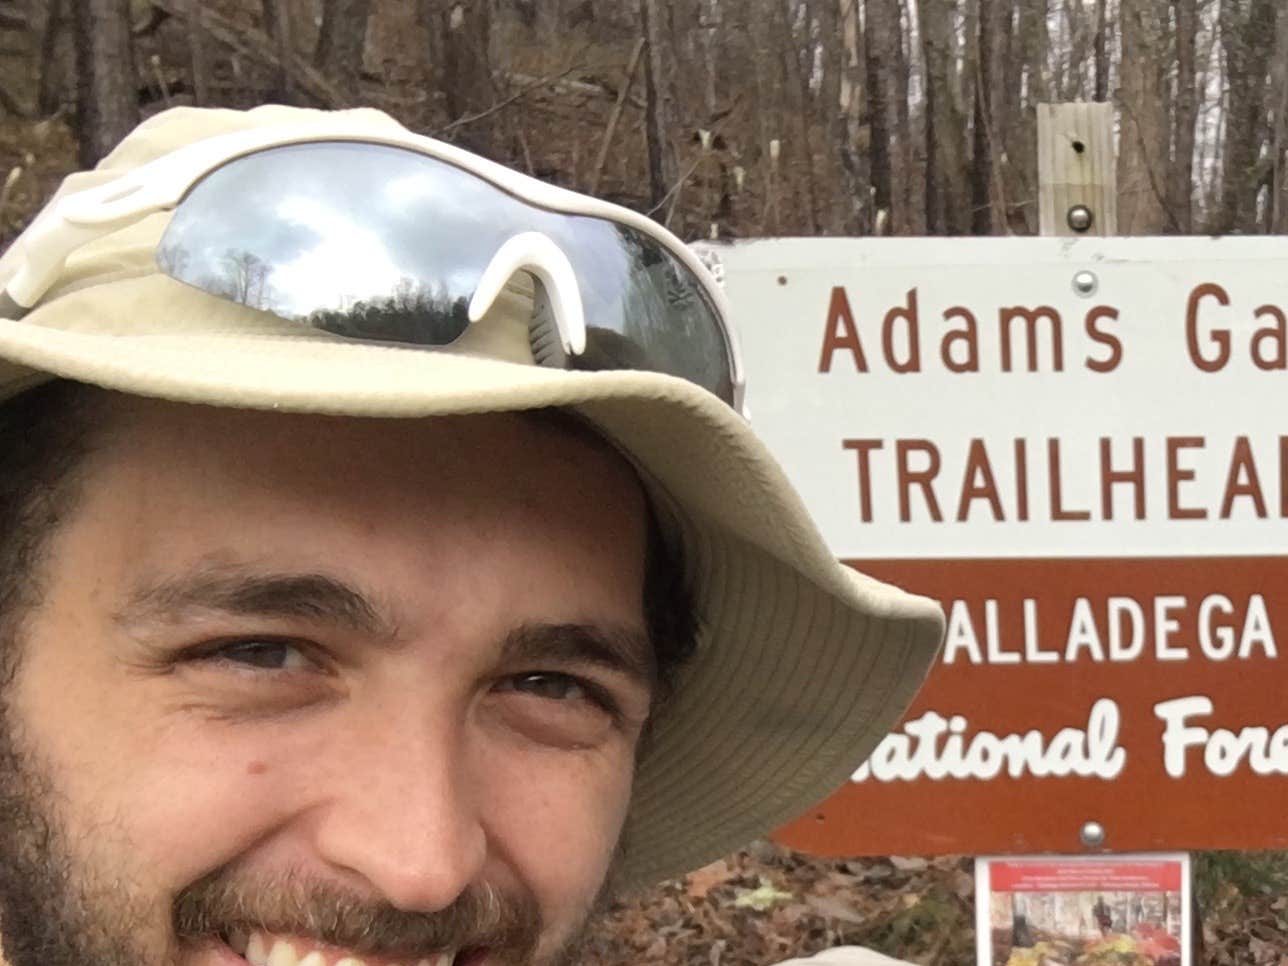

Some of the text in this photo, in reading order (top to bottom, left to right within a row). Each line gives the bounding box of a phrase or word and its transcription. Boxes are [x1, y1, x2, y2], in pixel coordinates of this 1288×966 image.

[818, 286, 1123, 374] Adams
[943, 594, 1278, 664] ALLADEGA
[850, 698, 1127, 783] ational
